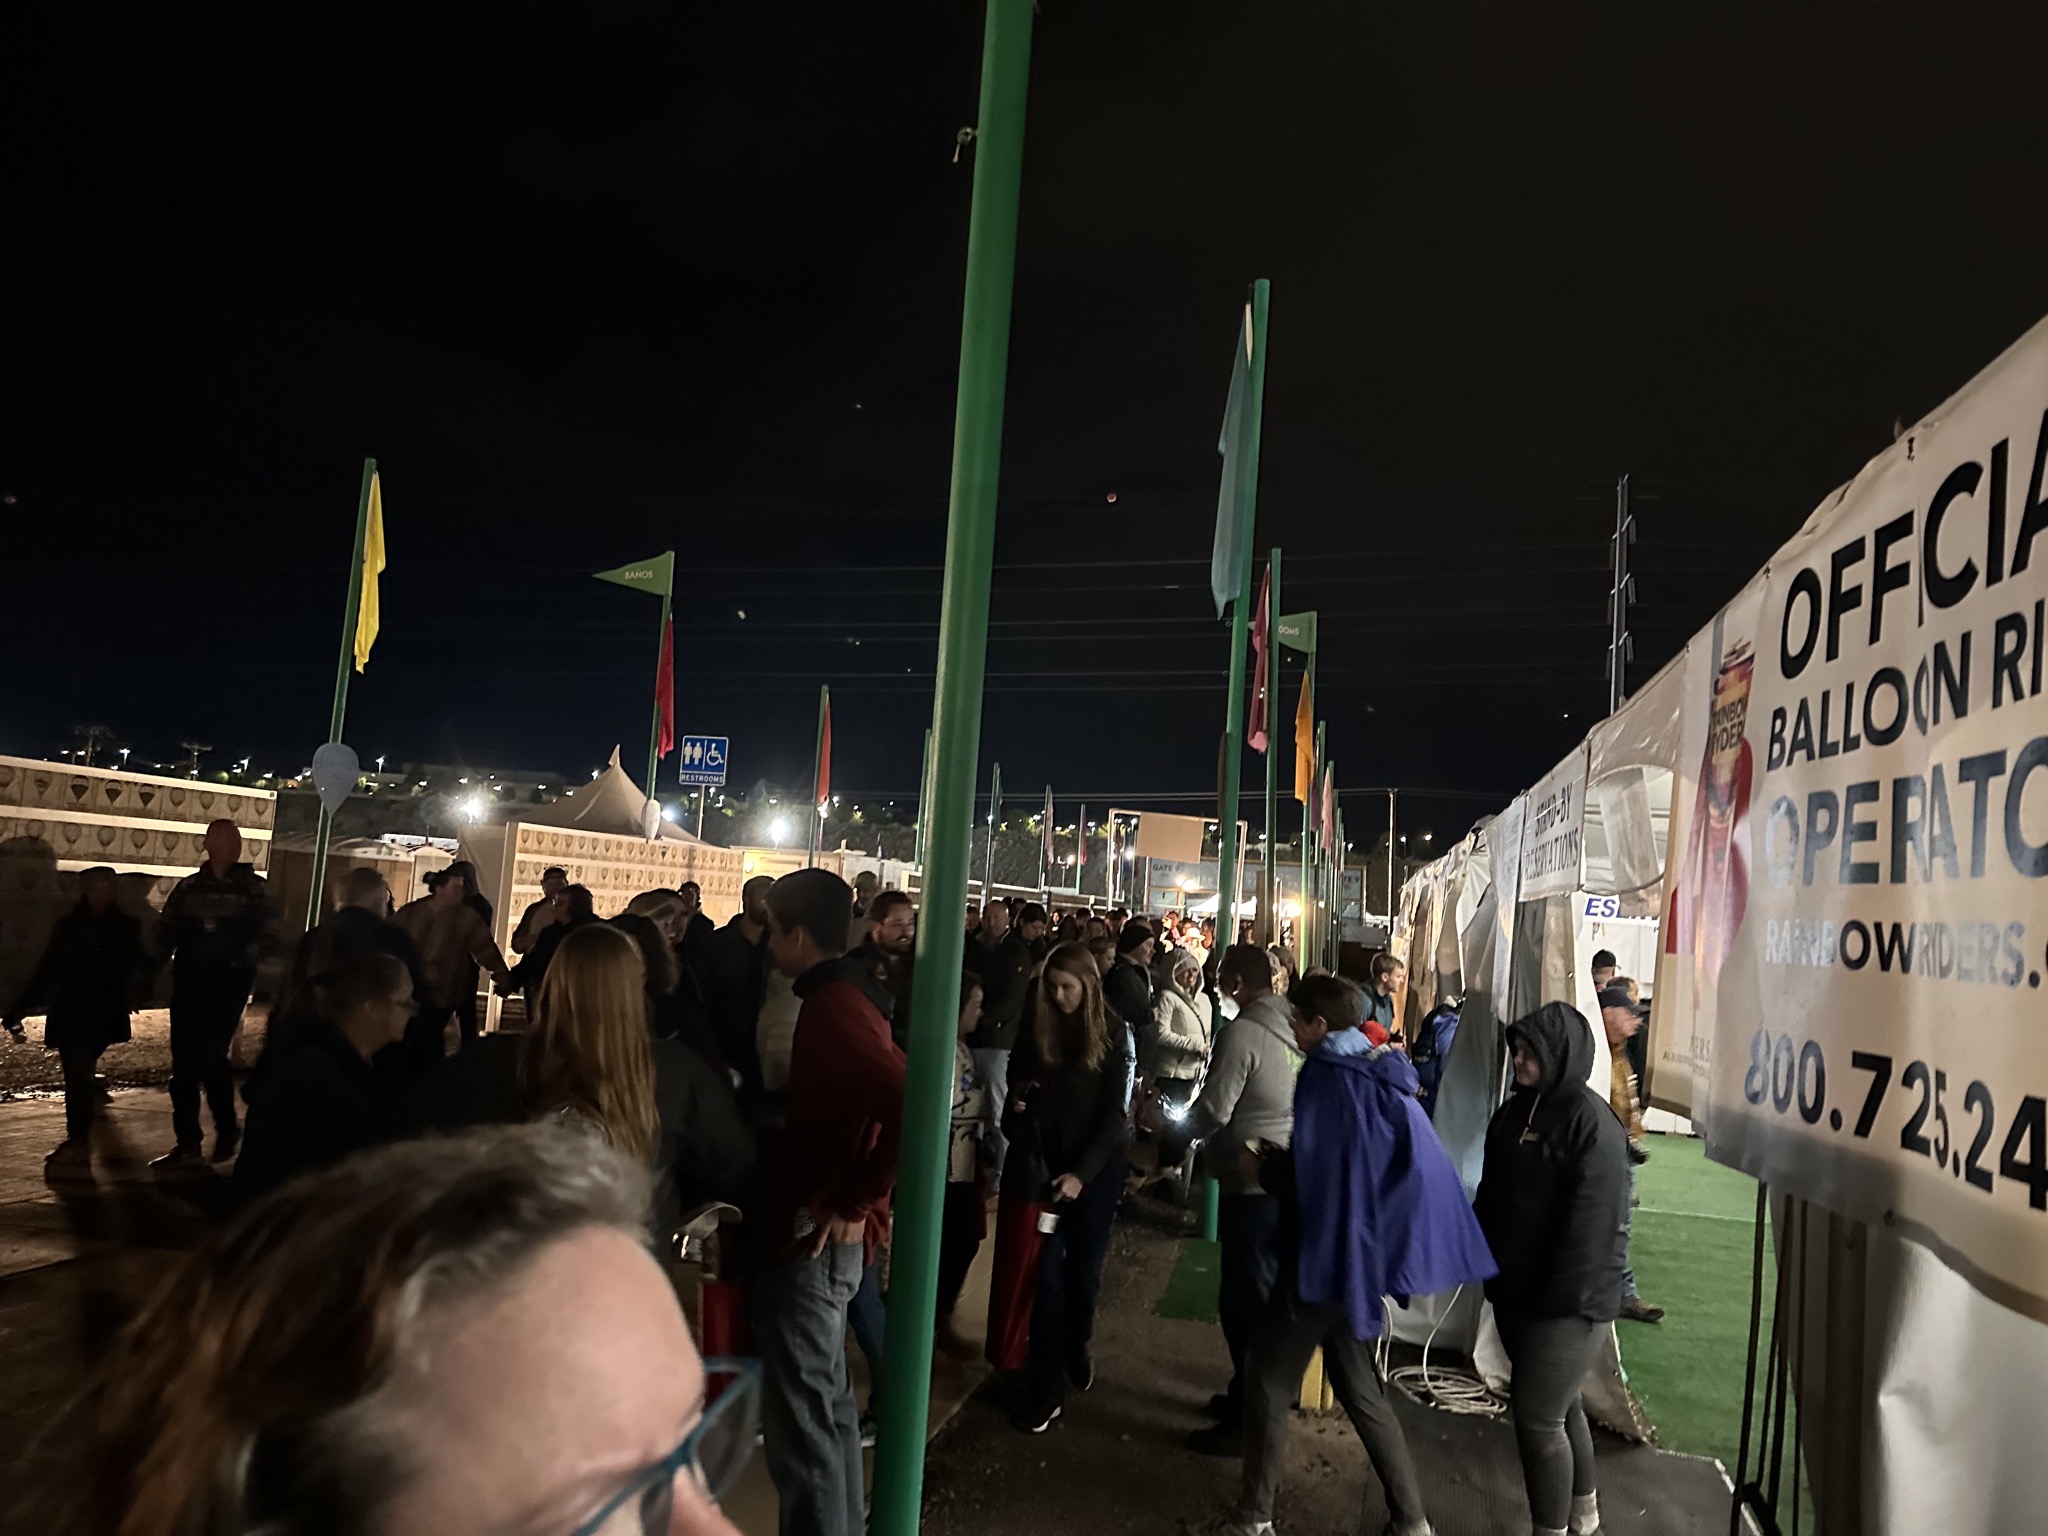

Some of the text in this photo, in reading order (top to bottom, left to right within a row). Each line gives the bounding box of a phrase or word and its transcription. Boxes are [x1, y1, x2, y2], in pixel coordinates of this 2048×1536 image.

[1767, 630, 1972, 772] BALLOON
[681, 774, 724, 783] RESTROOMS
[1765, 918, 2048, 989] RAINBOWRYDERS.
